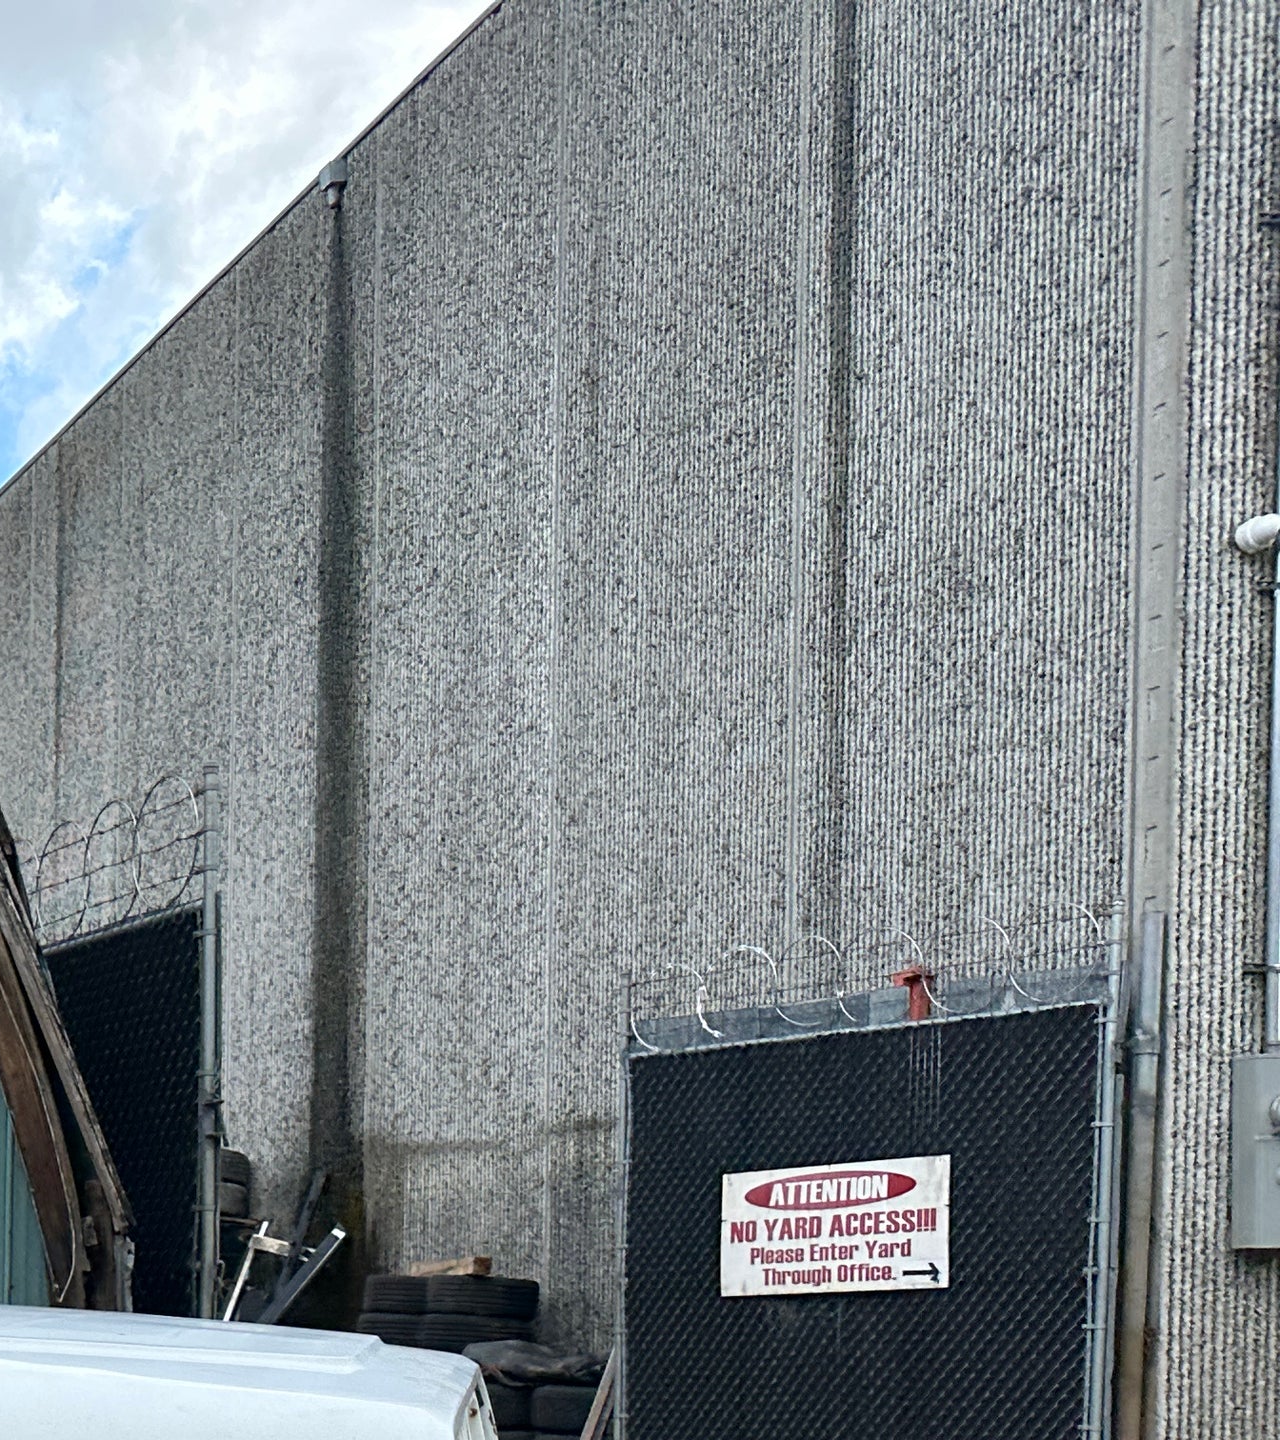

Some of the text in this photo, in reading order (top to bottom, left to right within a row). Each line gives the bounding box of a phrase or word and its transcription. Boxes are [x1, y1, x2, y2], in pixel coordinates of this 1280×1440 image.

[769, 1174, 889, 1207] ATTENTION
[730, 1208, 937, 1244] NO YARD ACCESS!!!
[750, 1238, 912, 1265] Please Enter Yard
[762, 1266, 832, 1287] Through
